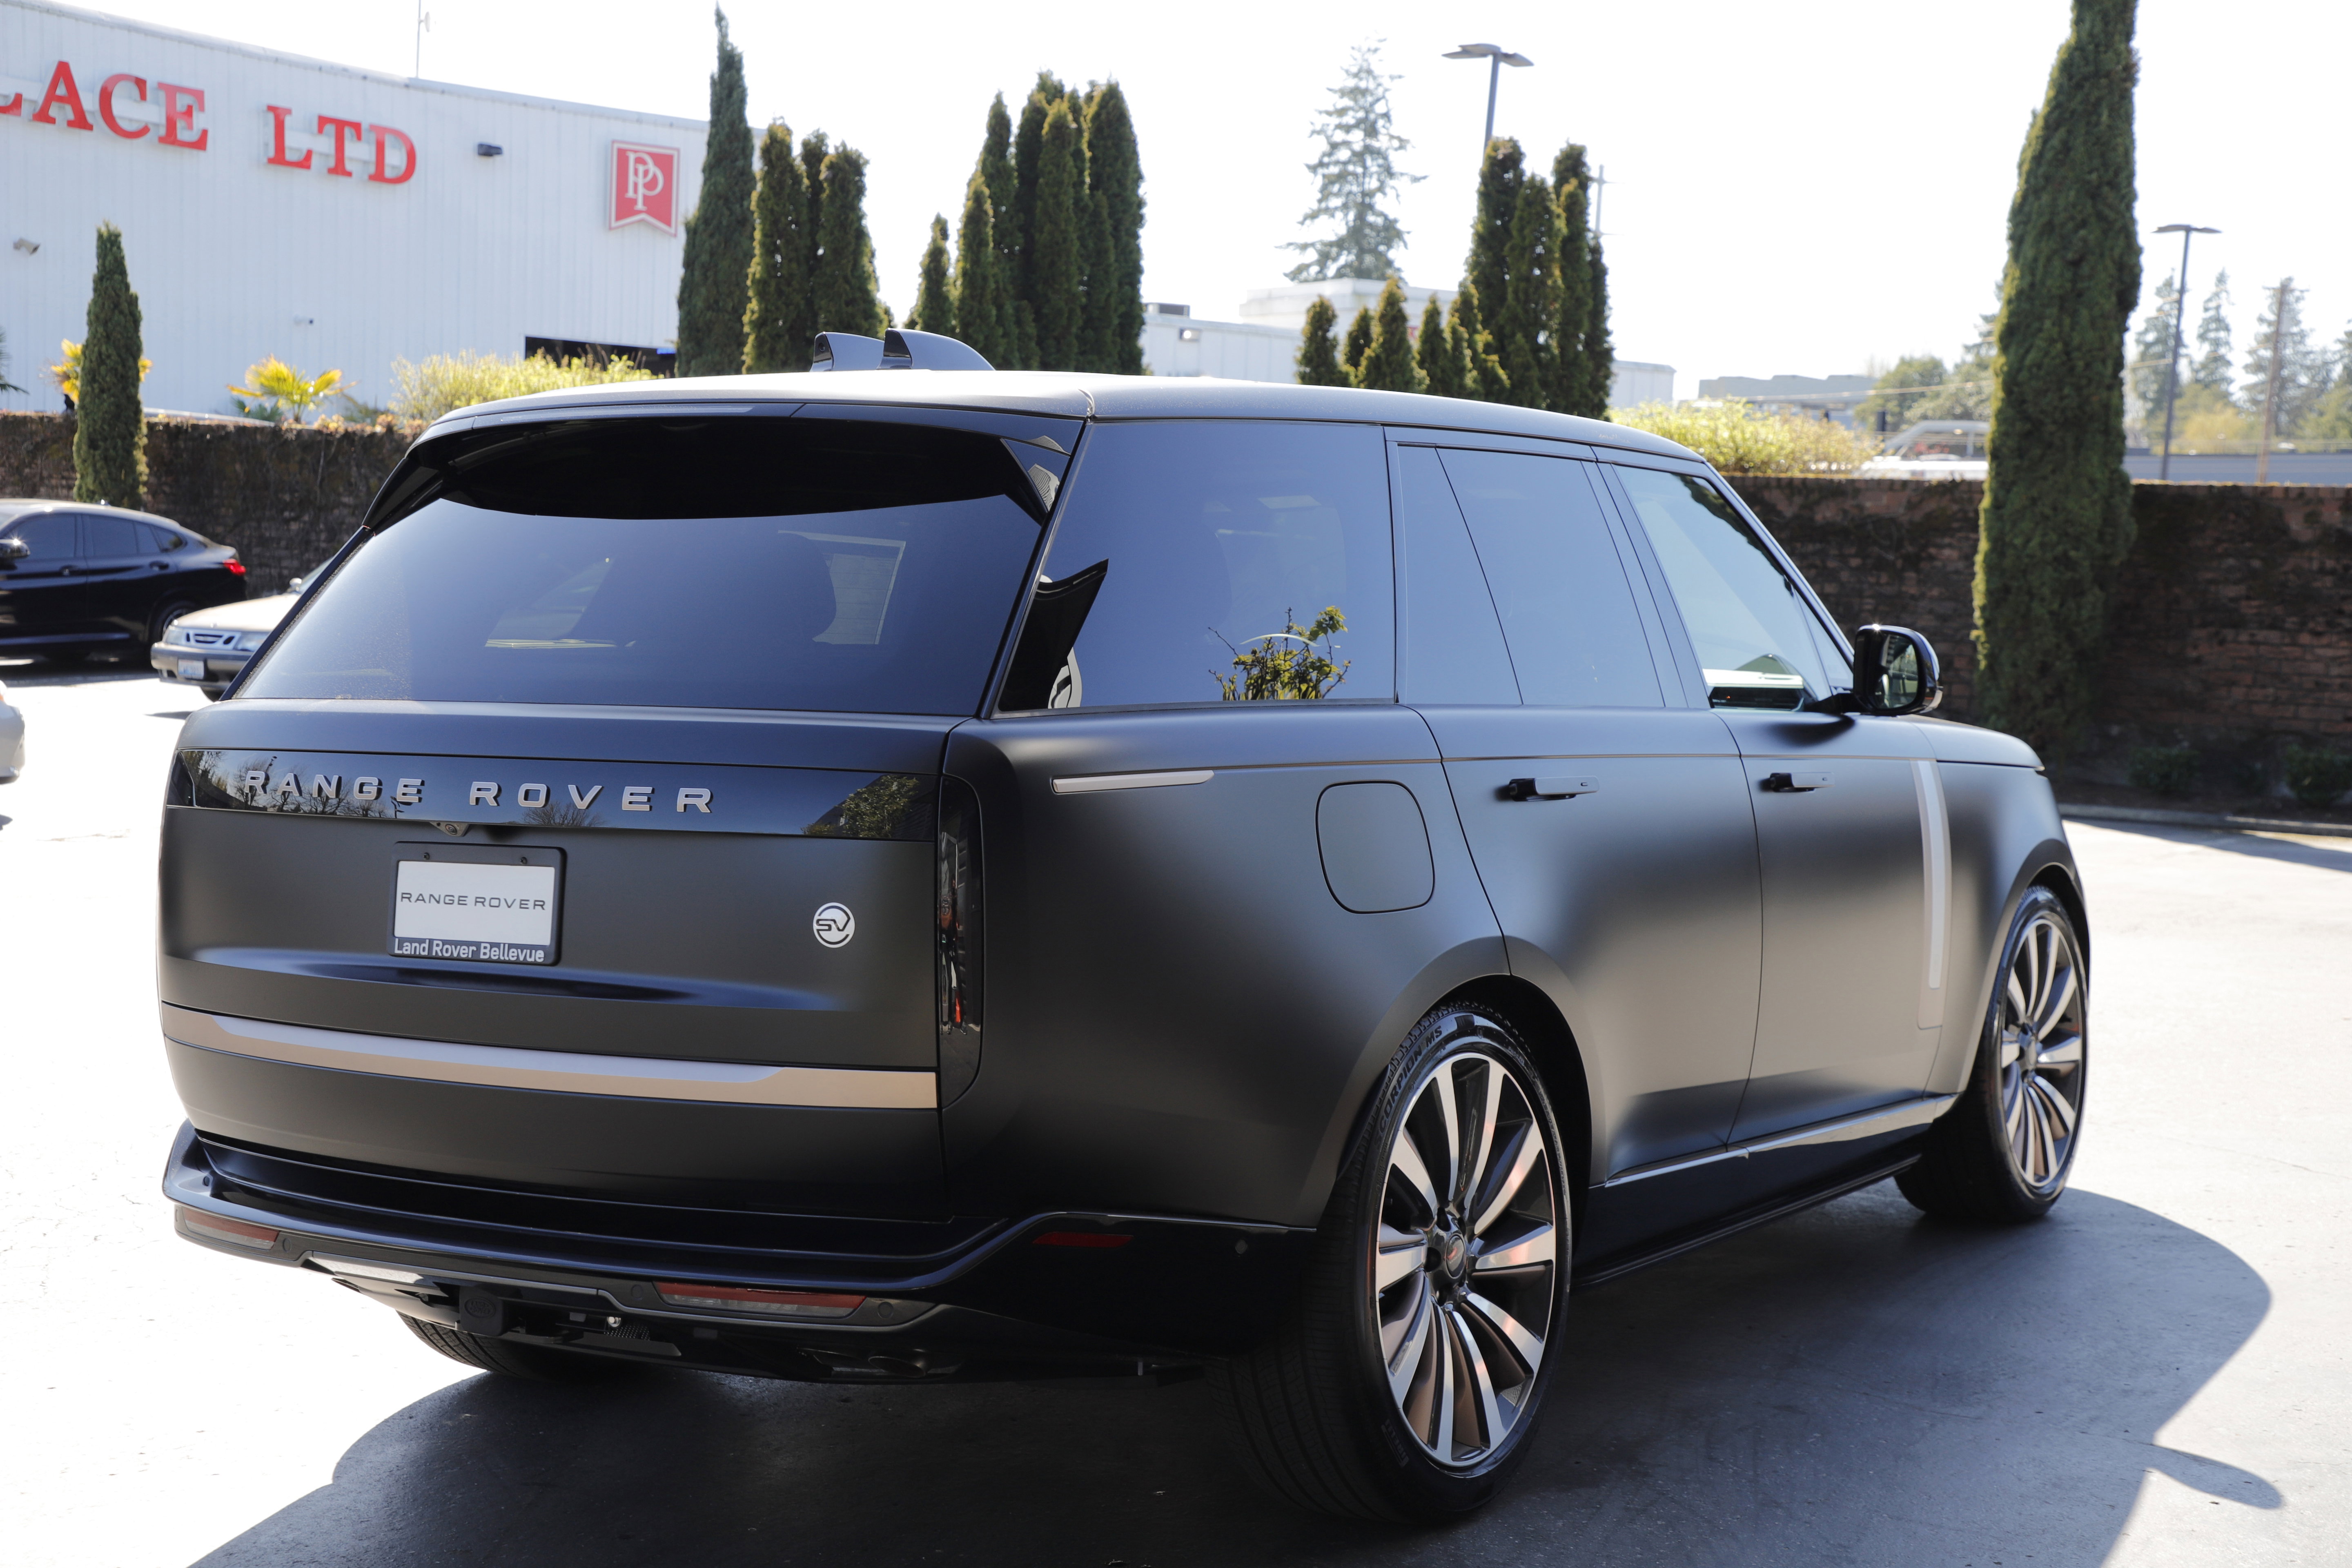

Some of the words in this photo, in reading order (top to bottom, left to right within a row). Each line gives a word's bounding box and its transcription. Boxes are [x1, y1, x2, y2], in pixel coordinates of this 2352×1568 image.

[0, 60, 208, 151] ACE
[266, 104, 417, 185] LTD
[245, 770, 424, 803] RANGE
[469, 781, 714, 813] ROVER
[400, 892, 468, 906] RANGE
[474, 896, 546, 911] ROVER
[394, 938, 429, 956] Land
[432, 940, 477, 958] Rover
[479, 942, 545, 962] Bellevue
